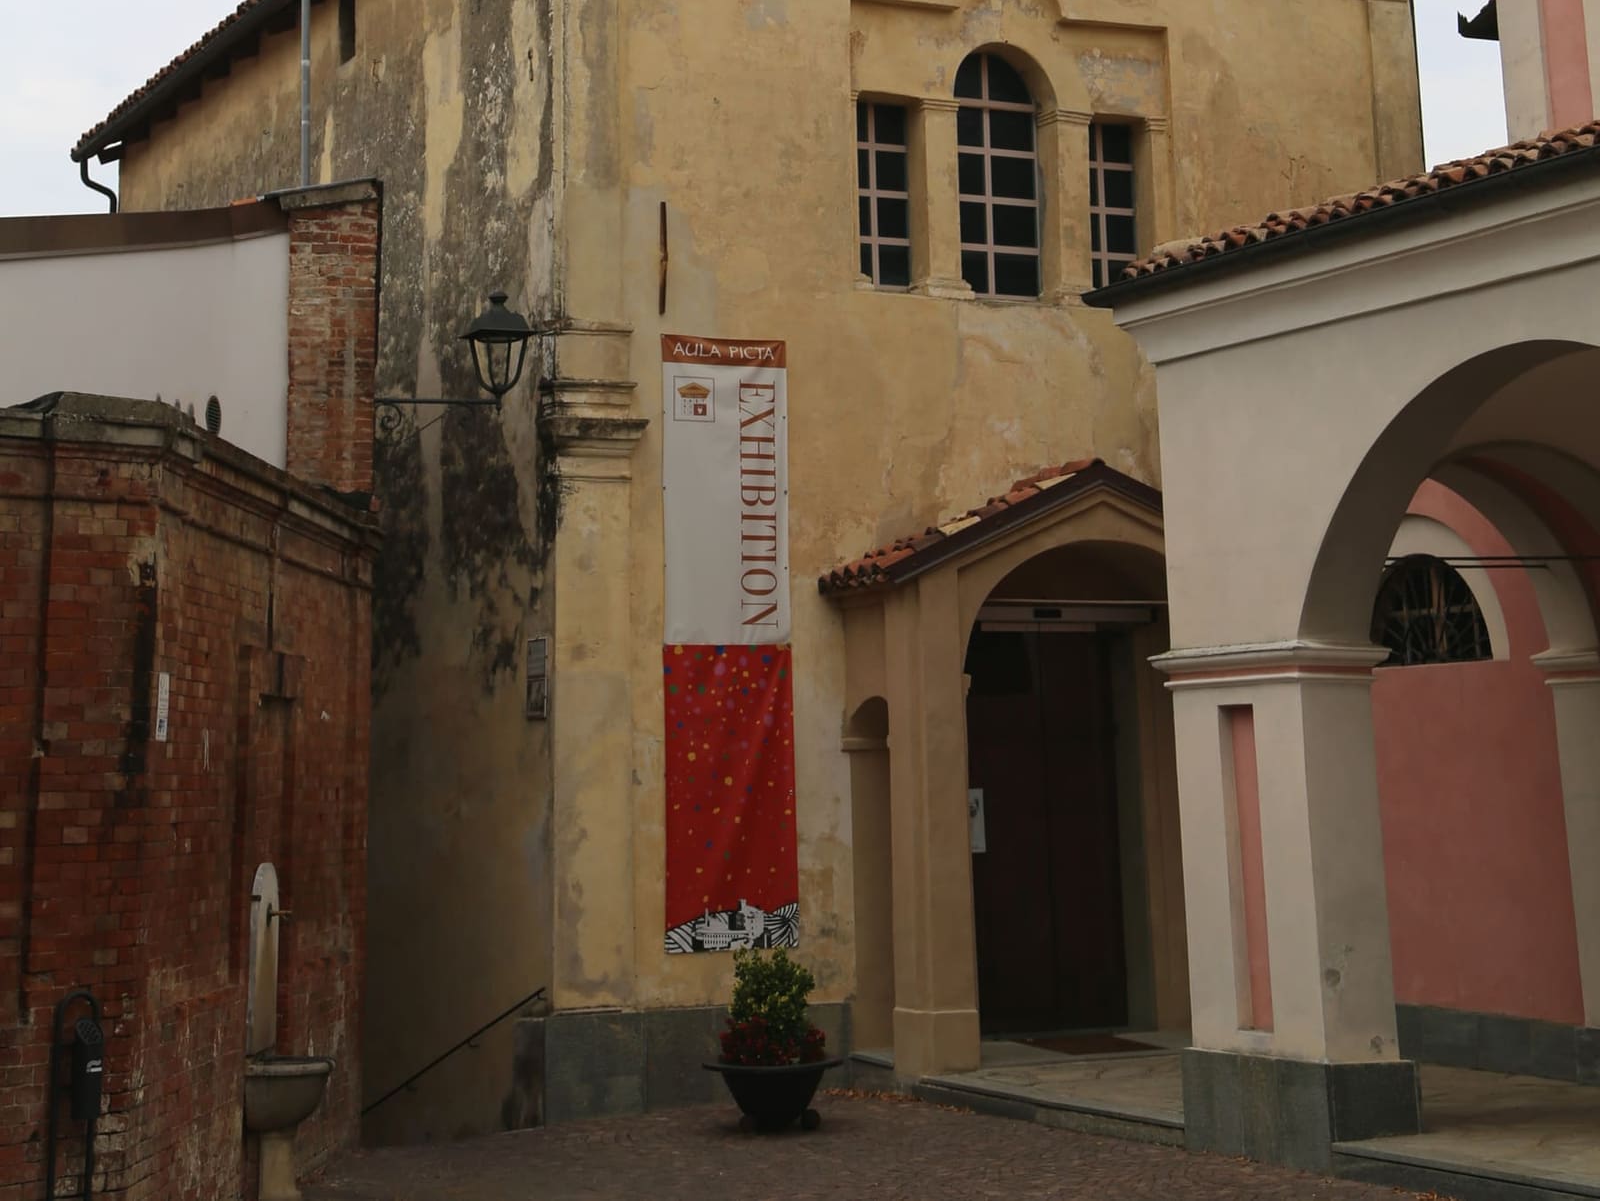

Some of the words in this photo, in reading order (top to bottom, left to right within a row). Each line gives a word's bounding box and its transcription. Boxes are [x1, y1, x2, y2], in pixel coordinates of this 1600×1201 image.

[672, 342, 721, 358] AULA
[728, 345, 775, 360] PICTA
[738, 378, 779, 629] EXHIBITION
